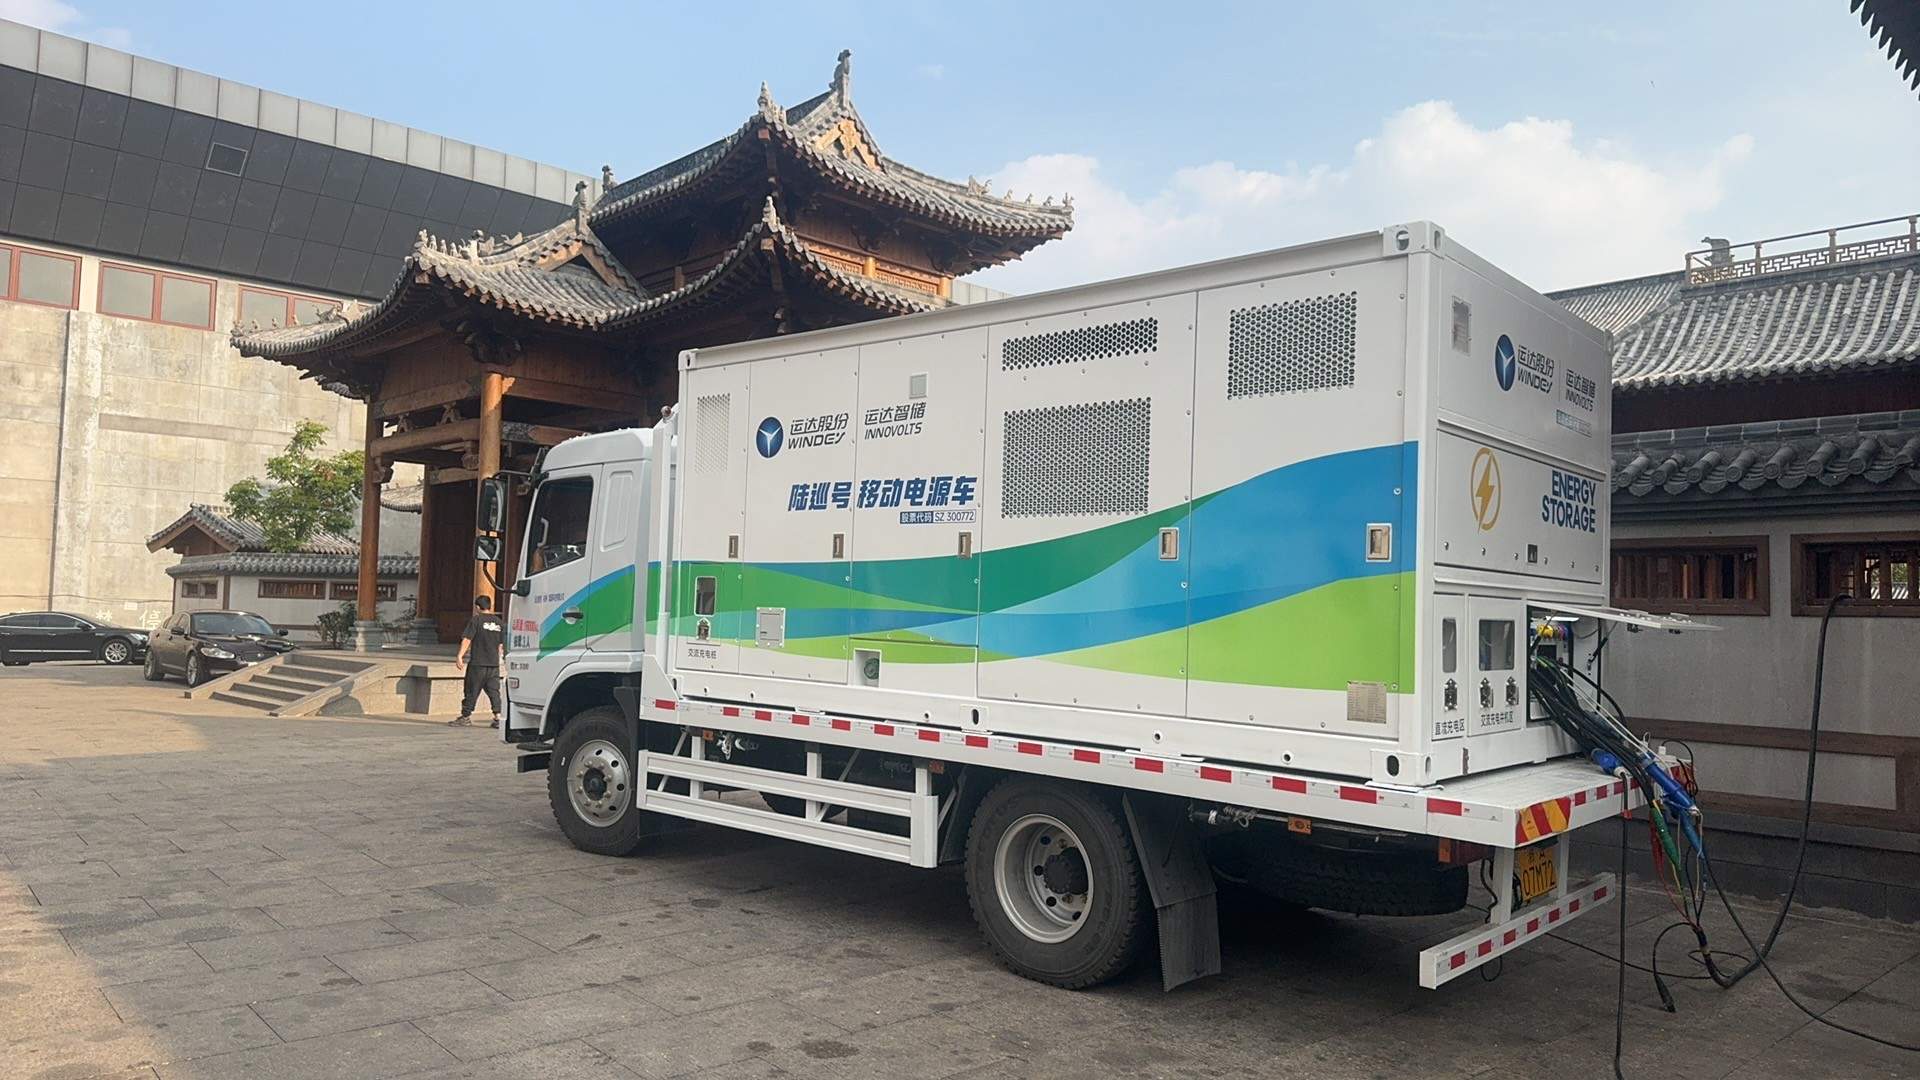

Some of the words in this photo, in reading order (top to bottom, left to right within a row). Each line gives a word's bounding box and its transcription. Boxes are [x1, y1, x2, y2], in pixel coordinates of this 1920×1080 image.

[1517, 367, 1553, 394] WINDEY
[790, 413, 850, 436] 运达股份
[864, 402, 926, 425] 运达智储
[788, 431, 846, 450] WINDEY
[864, 422, 923, 440] INNOVOLTS
[1552, 470, 1596, 506] ENERGY
[901, 511, 933, 524] 股票代码
[935, 512, 945, 522] SZ
[946, 511, 975, 522] 300772
[1542, 494, 1596, 533] STORAGE
